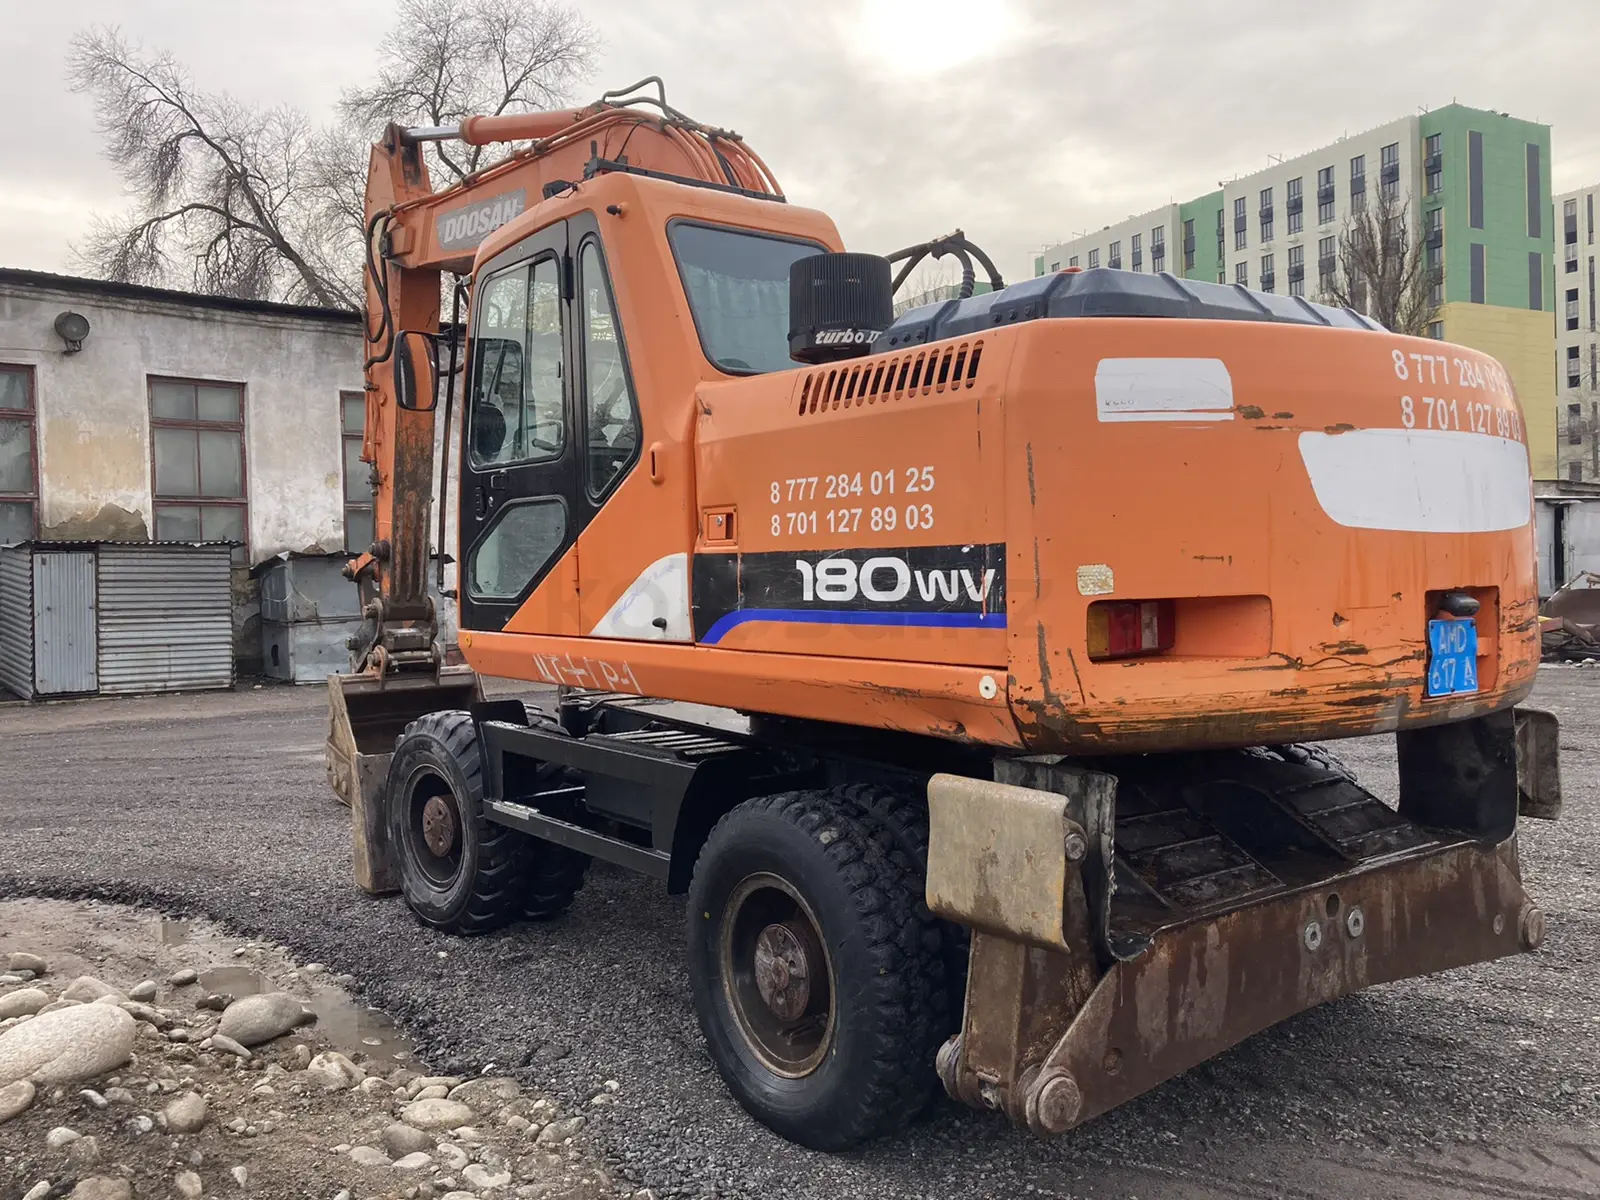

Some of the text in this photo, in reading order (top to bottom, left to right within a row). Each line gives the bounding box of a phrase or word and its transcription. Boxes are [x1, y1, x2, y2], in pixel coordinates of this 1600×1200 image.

[443, 198, 519, 243] DOOSAN
[815, 328, 864, 345] turbo
[1391, 349, 1409, 380] 8
[1409, 353, 1449, 385] 777
[1453, 357, 1485, 390] 284
[1400, 396, 1415, 428] 8
[1422, 397, 1460, 431] 701
[1466, 401, 1492, 434] 127
[1495, 407, 1510, 438] 89
[770, 466, 935, 504] 8 777 284 01 25
[770, 504, 934, 537] 8 701 127 89 03
[1463, 656, 1475, 687] A
